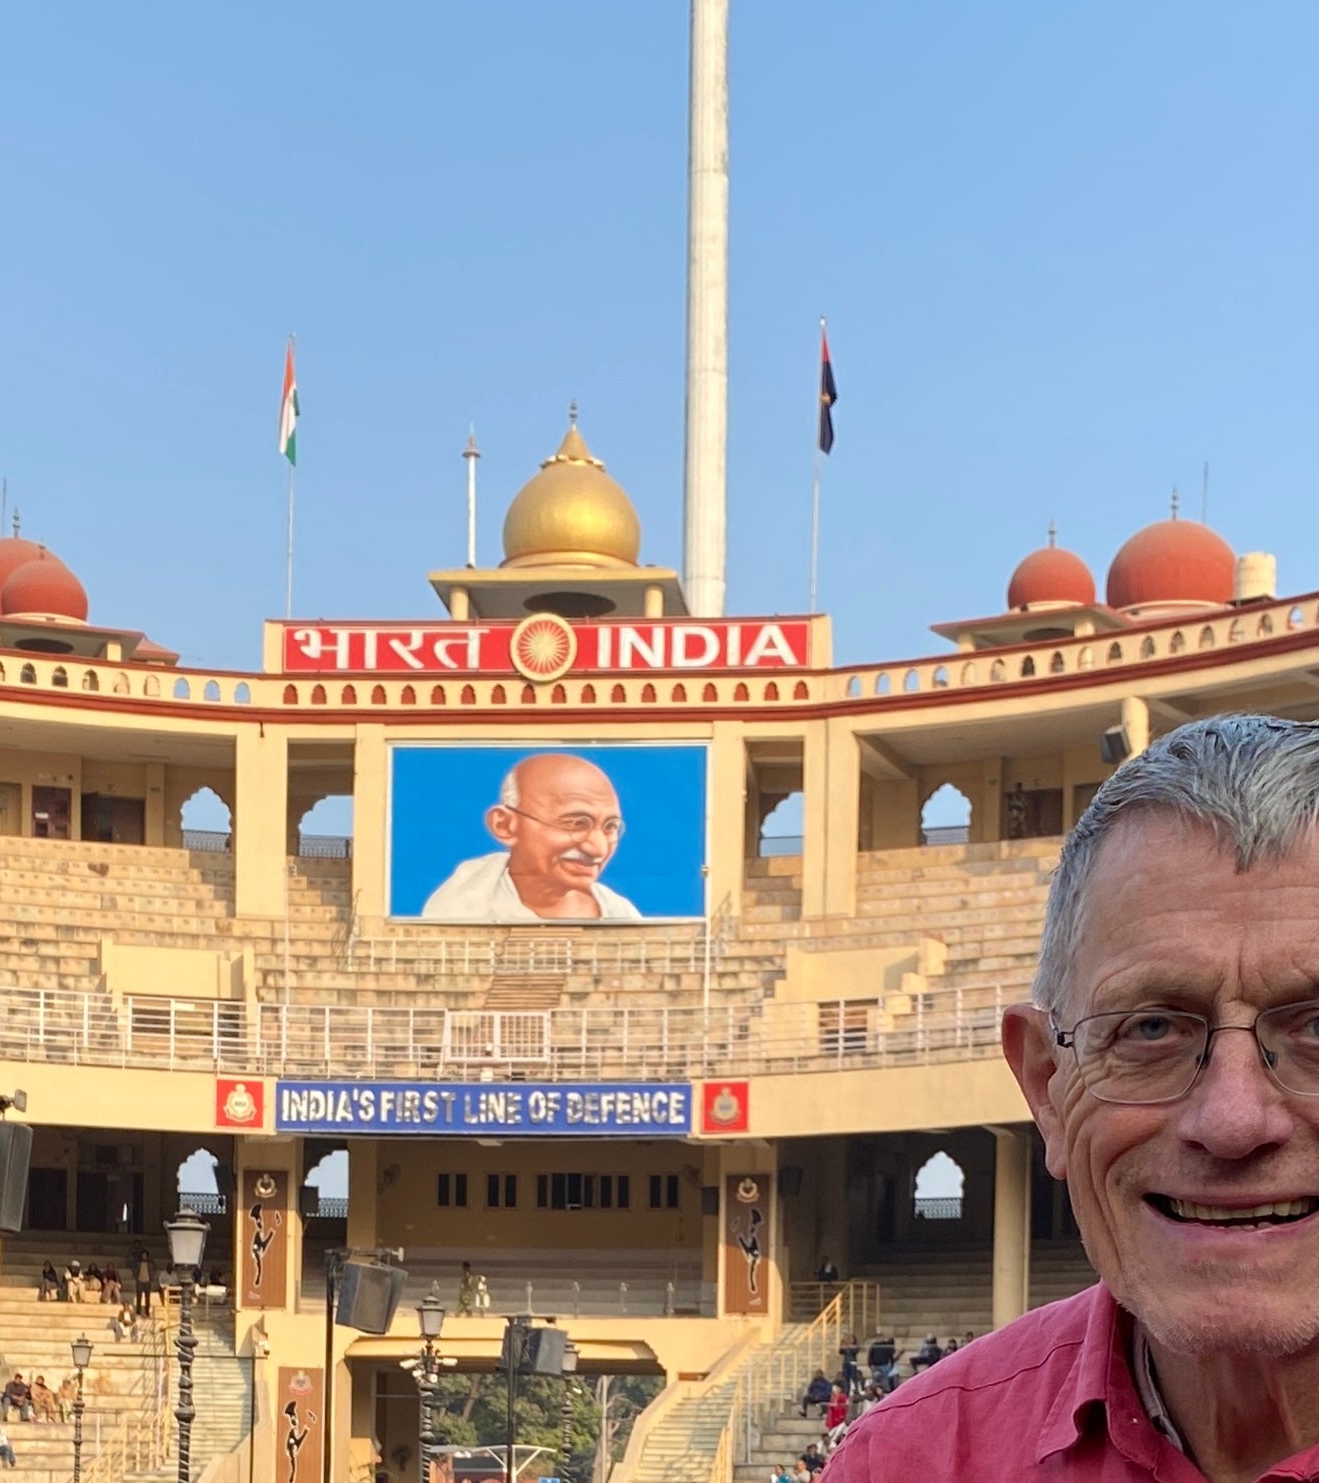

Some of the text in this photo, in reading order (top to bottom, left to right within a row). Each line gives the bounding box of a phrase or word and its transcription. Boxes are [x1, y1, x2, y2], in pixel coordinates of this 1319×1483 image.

[294, 629, 490, 669] भारत
[598, 624, 799, 668] INDIA
[282, 1088, 686, 1124] INDIA'S FIRST LINE OF DEFENCE
